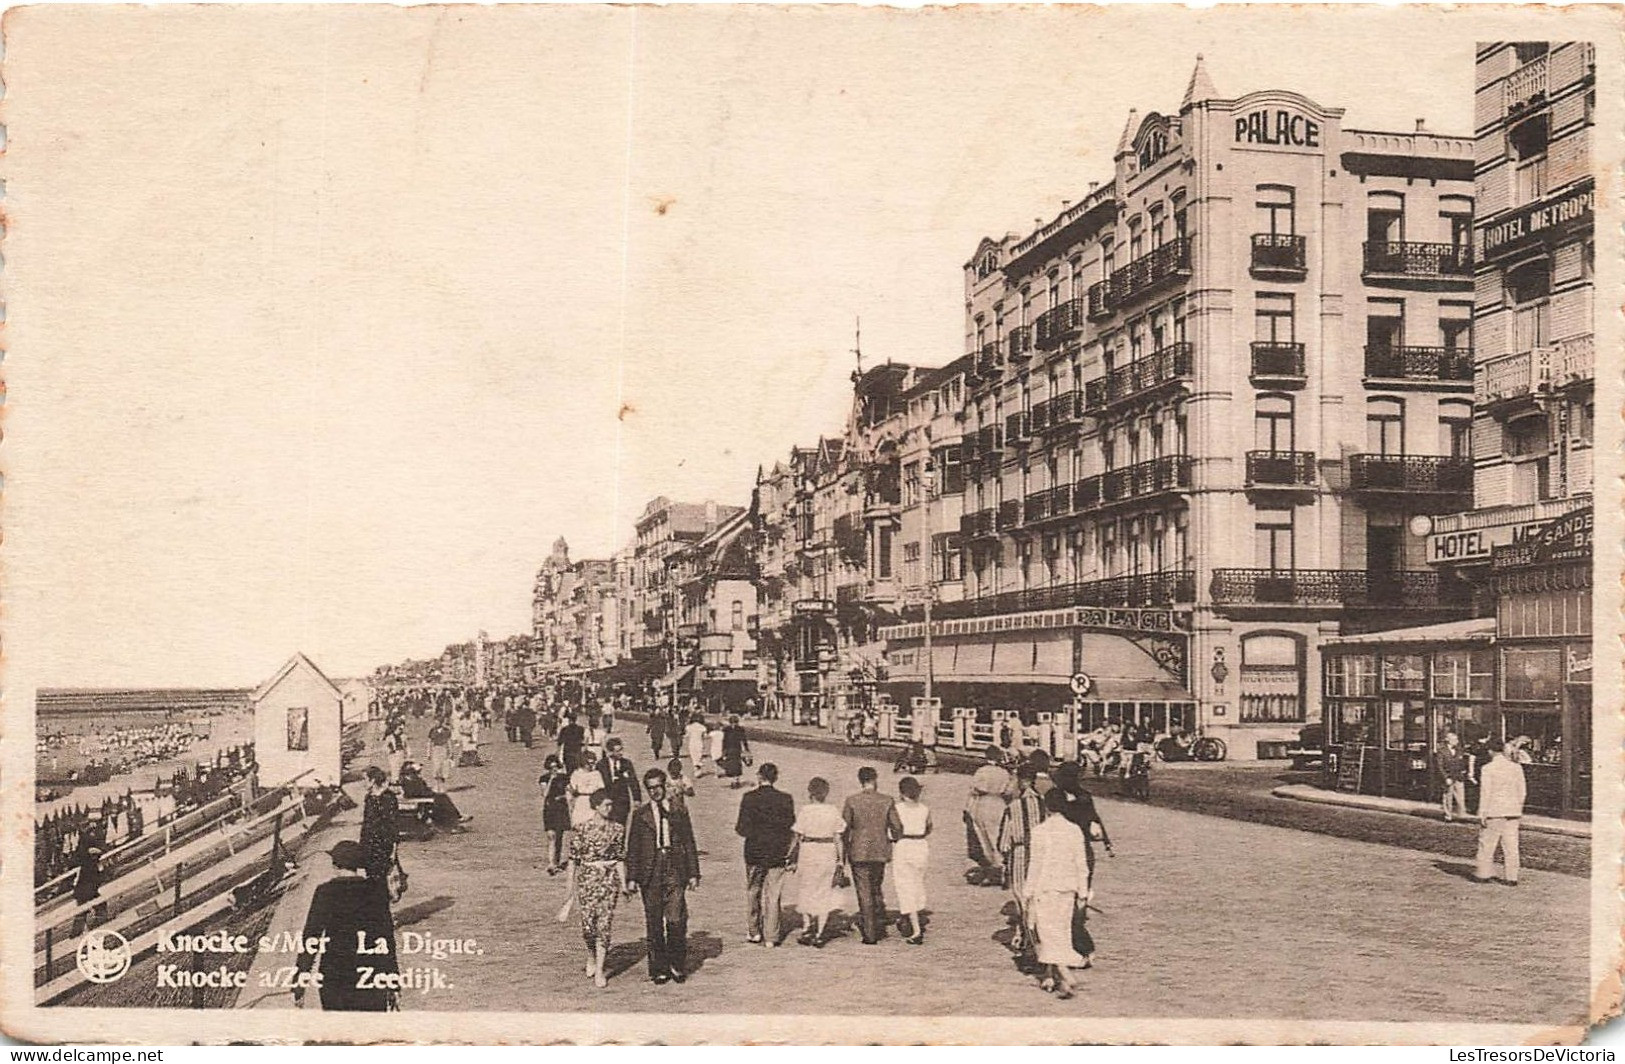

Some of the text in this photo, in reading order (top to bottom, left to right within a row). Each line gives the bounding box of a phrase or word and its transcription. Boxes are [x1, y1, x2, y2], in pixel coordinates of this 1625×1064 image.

[1235, 110, 1319, 147] PALACE
[1485, 217, 1525, 250] HOTEL
[1434, 531, 1489, 559] HOTEL
[1077, 610, 1168, 630] PALACE
